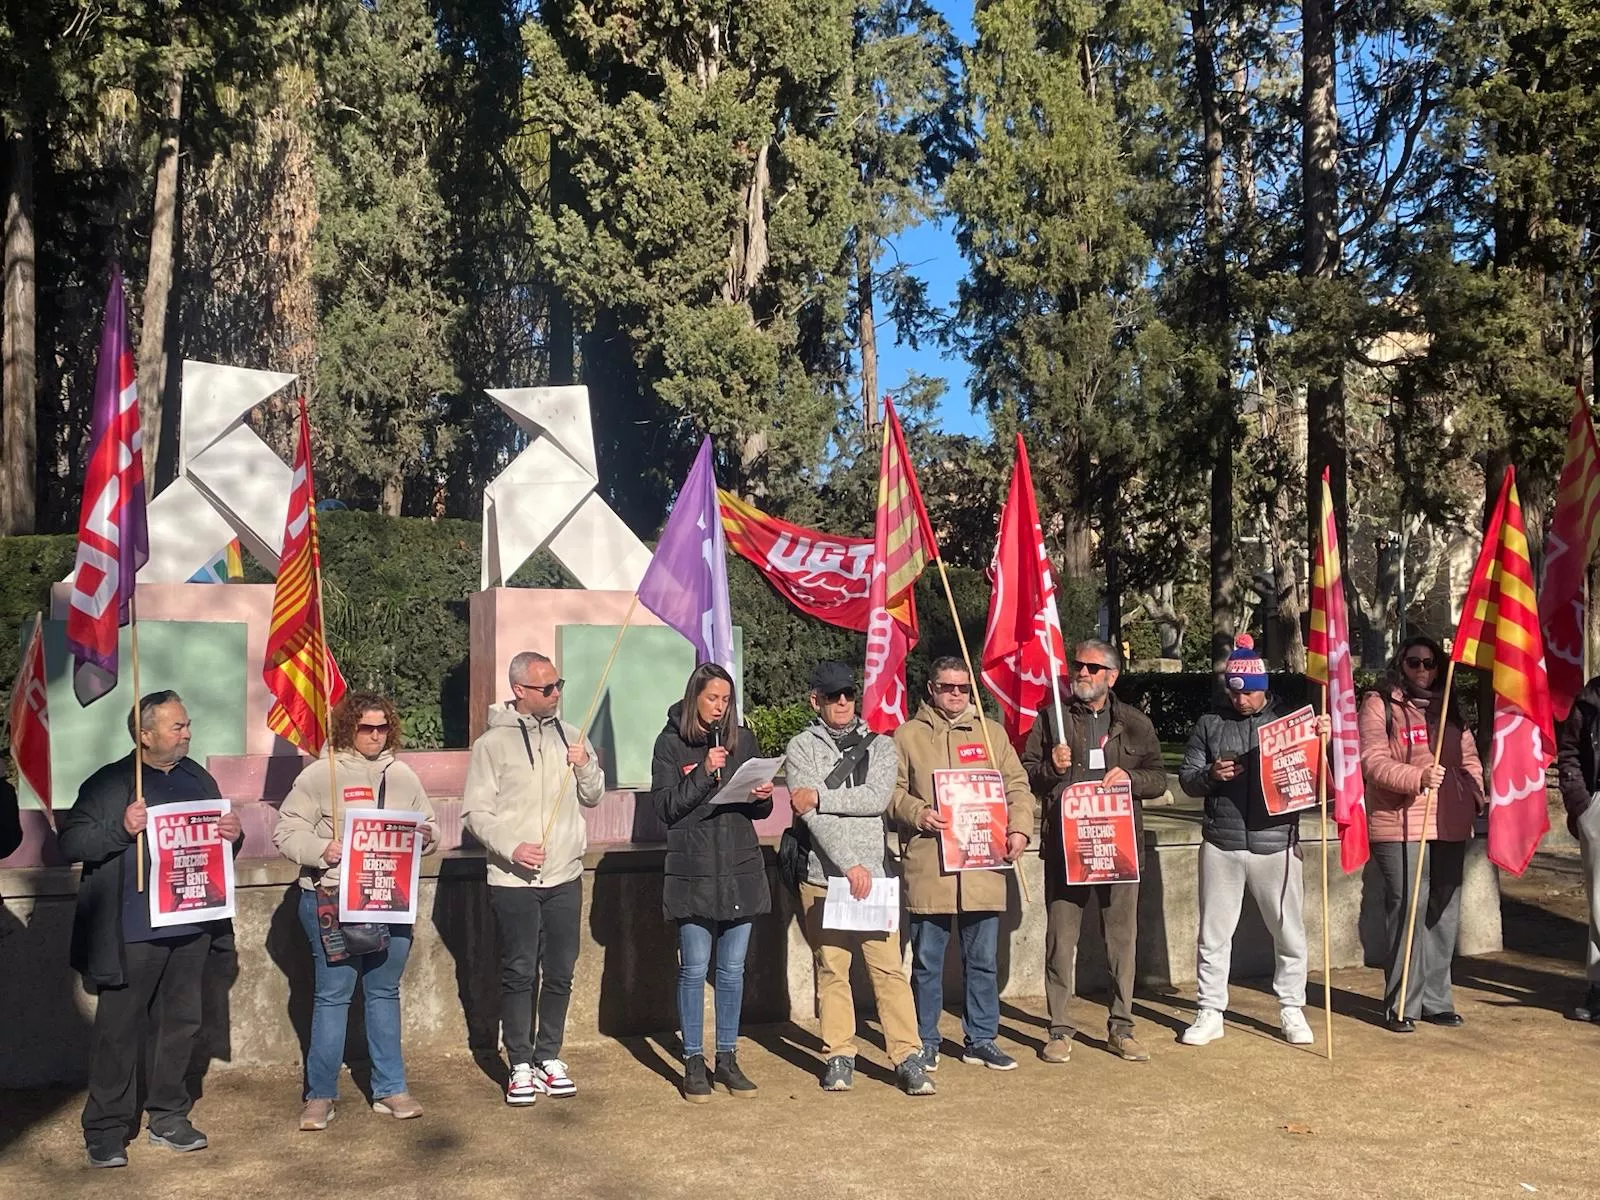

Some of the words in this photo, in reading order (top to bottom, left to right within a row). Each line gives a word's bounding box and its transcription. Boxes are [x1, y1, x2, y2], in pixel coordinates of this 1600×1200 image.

[766, 531, 875, 580] UGT
[1263, 728, 1271, 738] A
[1272, 724, 1286, 734] LA
[1262, 720, 1319, 757] CALLE
[1272, 750, 1307, 770] DERECHOS
[1287, 767, 1312, 784] GENTE
[939, 780, 1004, 806] CALLE
[1066, 788, 1074, 797] A
[1075, 787, 1092, 796] LA
[1288, 782, 1313, 798] JUEGA
[1064, 795, 1131, 819] CALLE
[159, 818, 168, 829] A
[170, 816, 186, 827] LA
[355, 822, 364, 831] A
[366, 822, 382, 831] LA
[159, 824, 221, 850] CALLE
[970, 830, 992, 843] GENTE
[1077, 825, 1116, 840] DERECHOS
[353, 831, 413, 853] CALLE
[968, 843, 990, 857] JUEGA
[1093, 844, 1117, 857] GENTE
[173, 853, 209, 869] DERECHOS
[363, 859, 397, 871] DERECHOS
[1091, 857, 1115, 870] JUEGA
[186, 872, 209, 885] GENTE
[375, 877, 396, 889] GENTE
[182, 886, 206, 899] JUEGA
[370, 888, 392, 901] JUEGA
